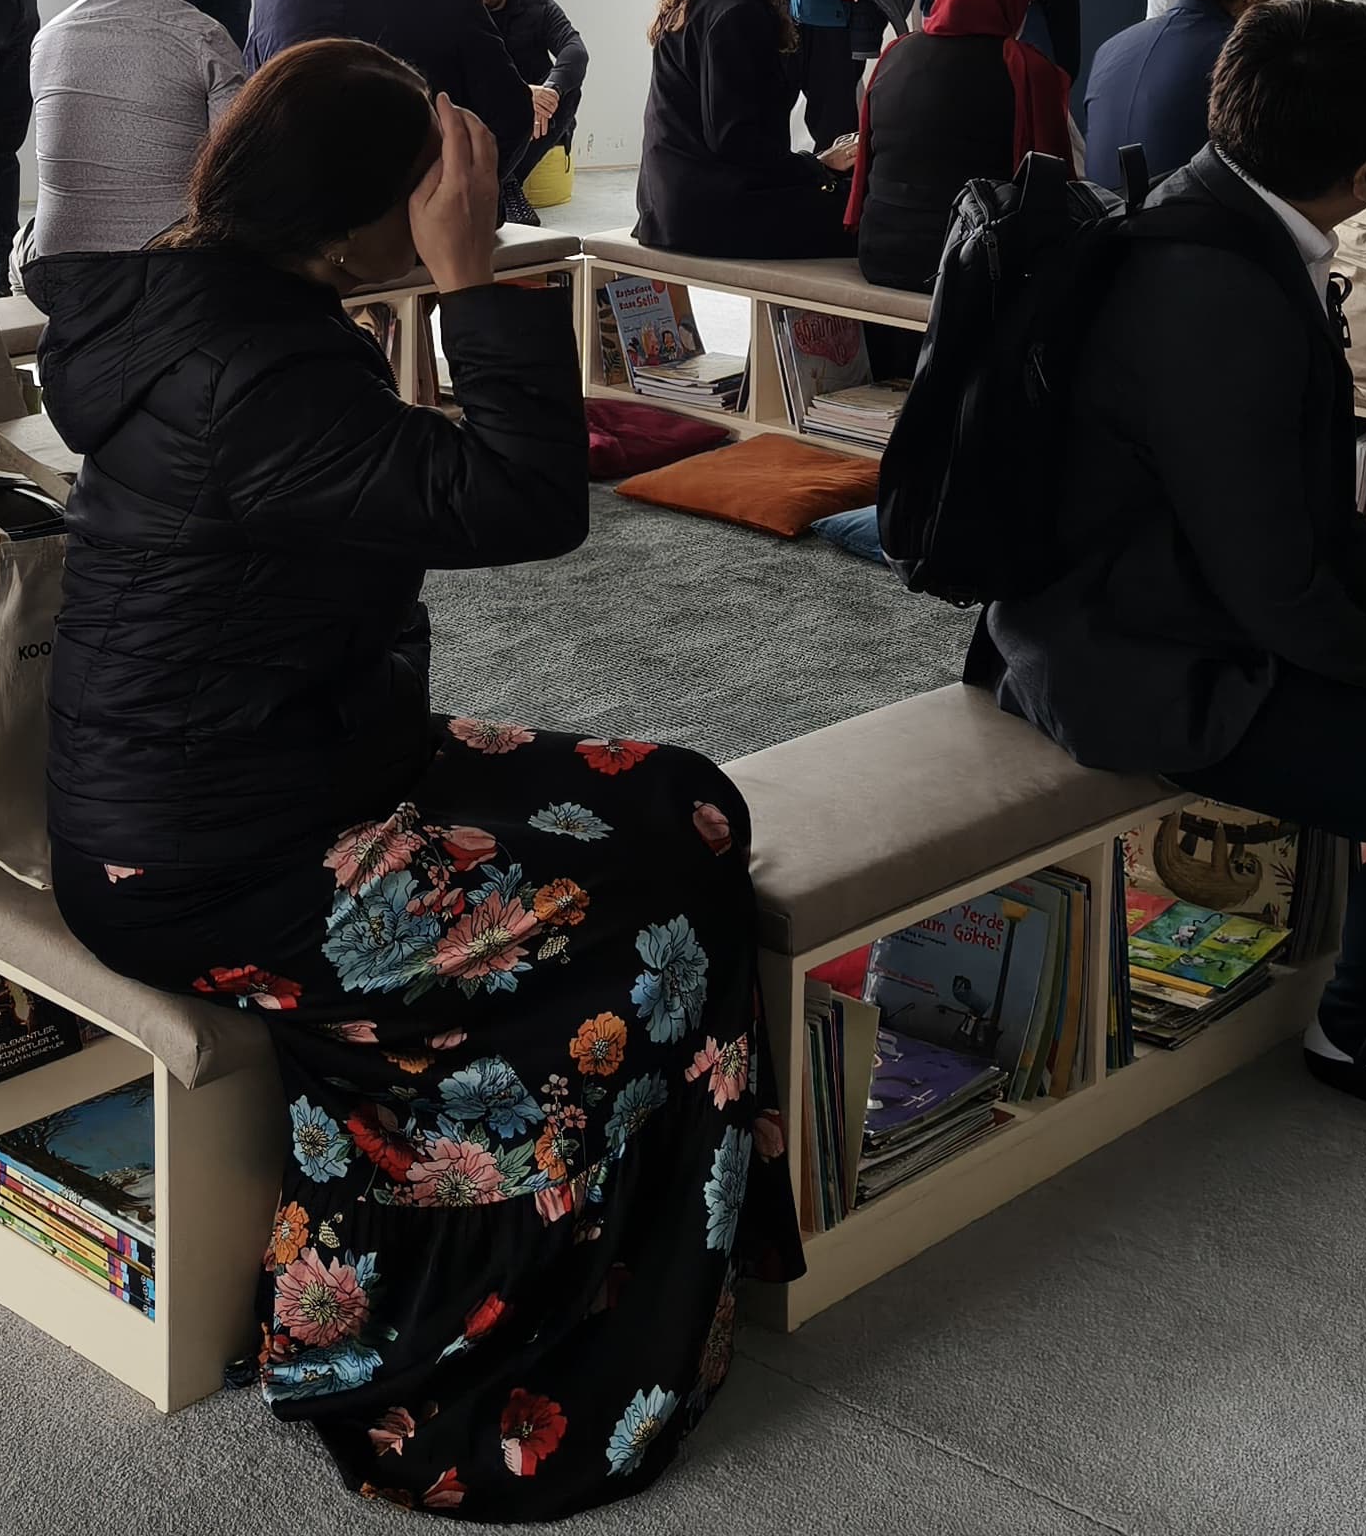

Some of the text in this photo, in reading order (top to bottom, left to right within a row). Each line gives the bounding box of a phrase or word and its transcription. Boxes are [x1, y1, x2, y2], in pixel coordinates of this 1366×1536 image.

[18, 638, 53, 662] KOO
[961, 905, 1004, 932] Yerde
[953, 924, 1002, 952] Gökte!
